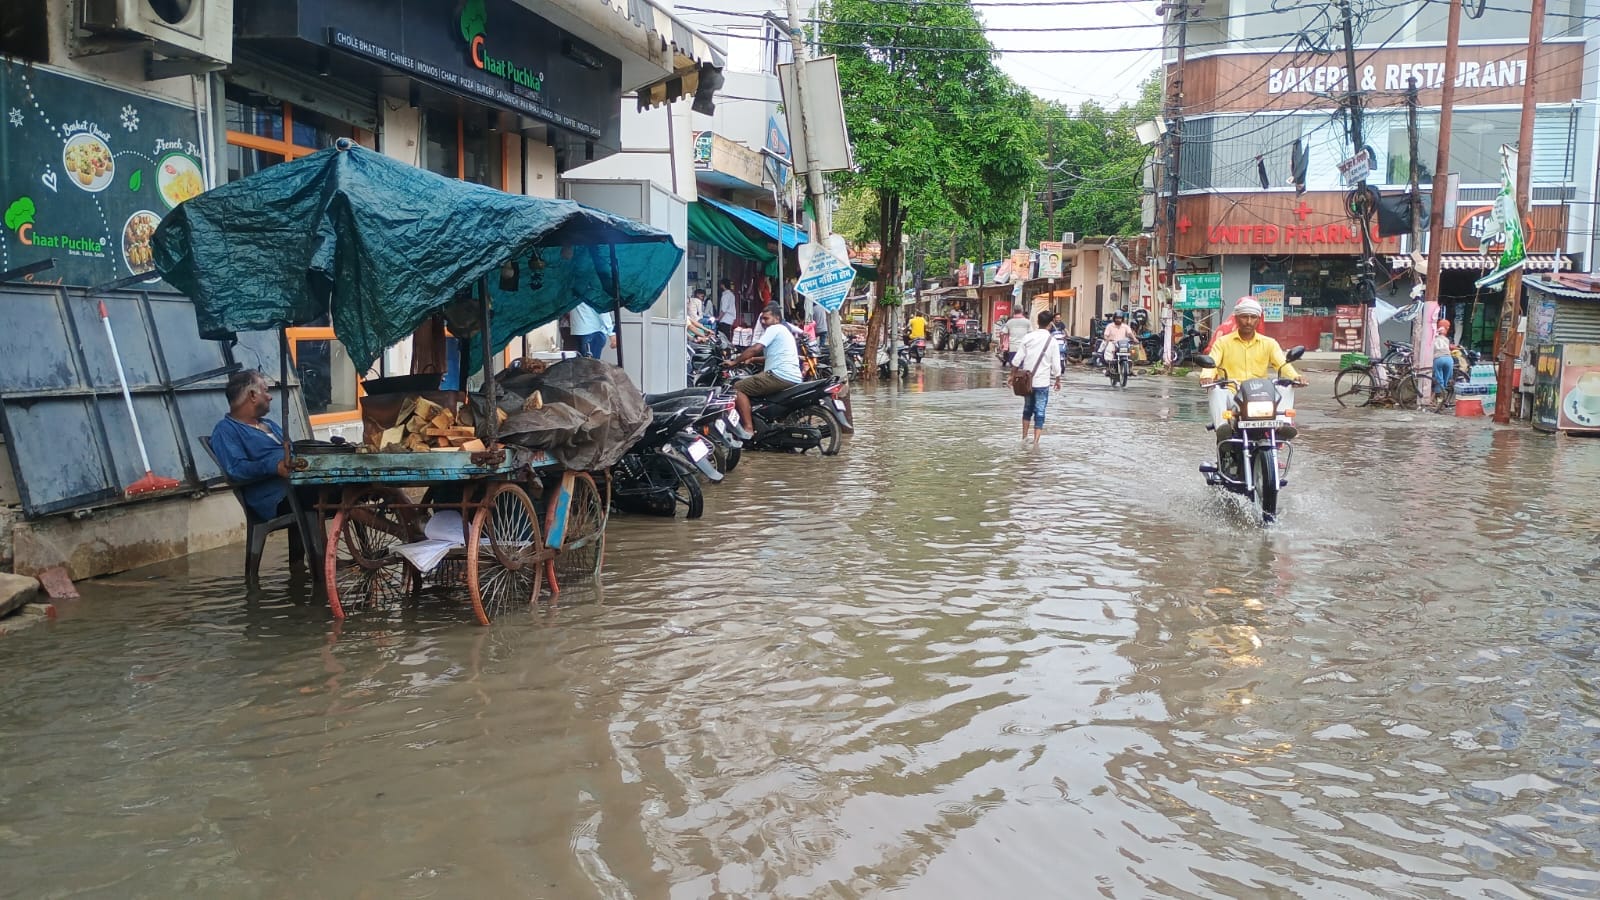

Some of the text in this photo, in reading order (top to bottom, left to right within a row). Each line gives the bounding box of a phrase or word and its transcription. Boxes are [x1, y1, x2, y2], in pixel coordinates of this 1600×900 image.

[337, 32, 358, 48] CHOLE
[360, 40, 387, 59] BHATURE
[390, 52, 414, 68] CHINESE
[417, 62, 438, 76] MOMOS
[441, 70, 458, 83] CHAAT
[460, 77, 474, 88] PIZZA
[476, 83, 495, 97] BURGER
[472, 35, 541, 92] Chaat Puchka
[1361, 65, 1376, 91] &
[62, 120, 88, 136] Basket
[153, 138, 183, 155] French
[19, 223, 59, 248] Chaat
[1208, 224, 1396, 244] UNITED PHARMC
